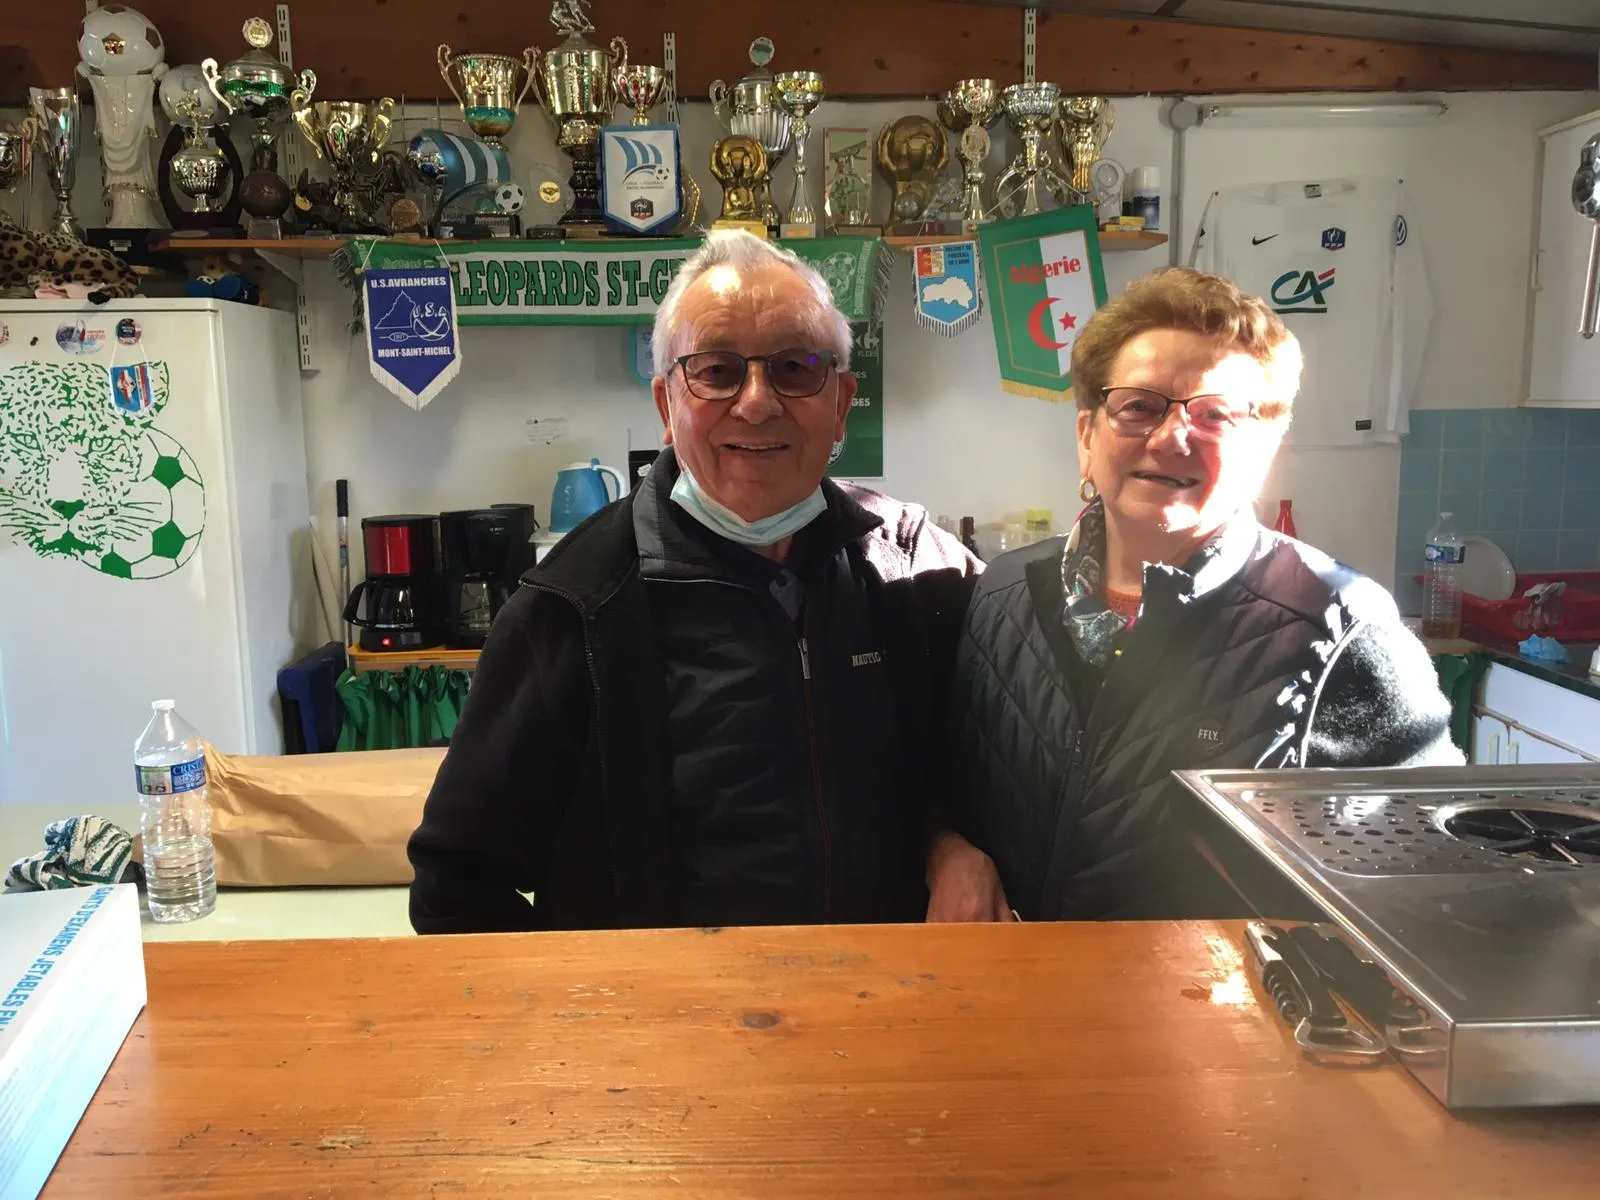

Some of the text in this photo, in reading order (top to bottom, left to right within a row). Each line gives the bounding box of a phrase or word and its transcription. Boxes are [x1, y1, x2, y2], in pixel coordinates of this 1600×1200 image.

[451, 259, 601, 307] LEOPARDS
[377, 346, 452, 359] MONT-SAINT-MICHEL
[2, 958, 56, 1007] JETABLES
